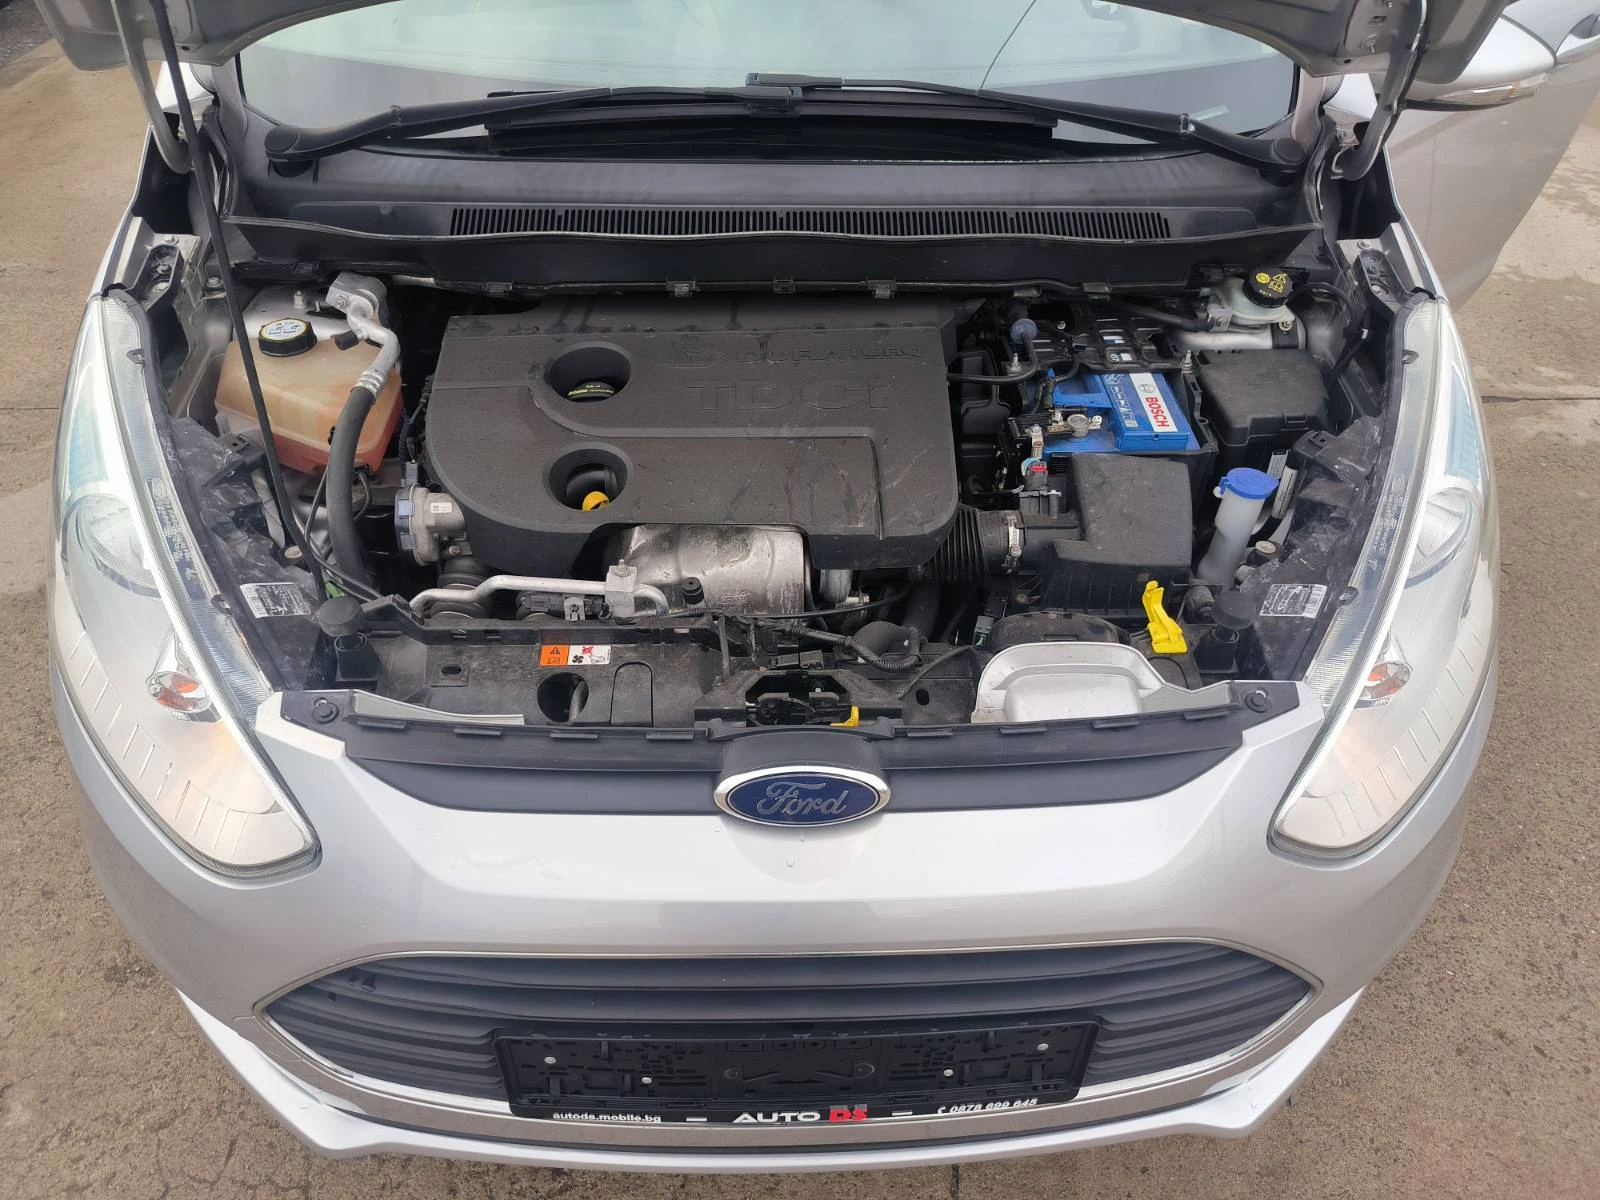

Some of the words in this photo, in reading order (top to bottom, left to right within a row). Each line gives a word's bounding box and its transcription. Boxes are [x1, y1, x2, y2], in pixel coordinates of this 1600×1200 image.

[1145, 396, 1171, 428] BOSCH
[756, 781, 849, 816] Ford
[552, 1111, 662, 1124] autods.mobile.bg
[732, 1111, 821, 1124] AUTO
[829, 1104, 868, 1122] DS
